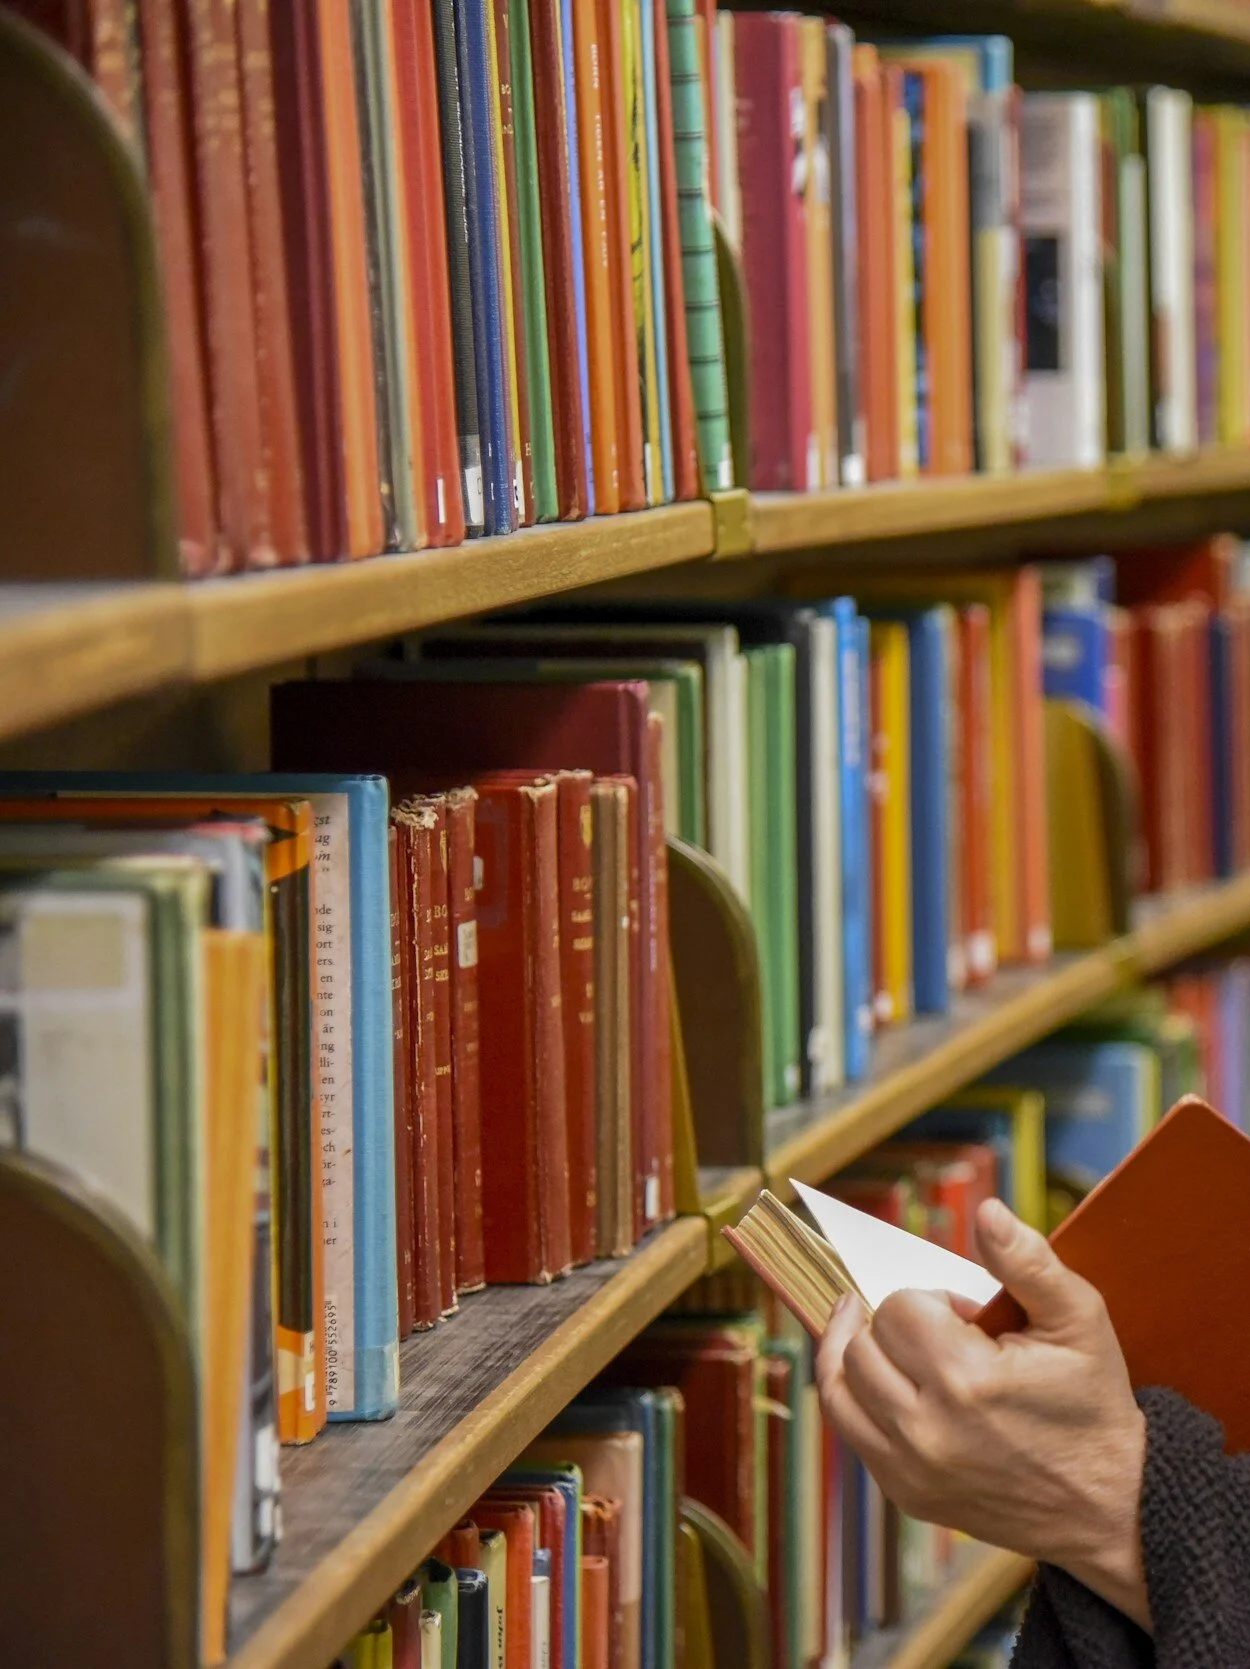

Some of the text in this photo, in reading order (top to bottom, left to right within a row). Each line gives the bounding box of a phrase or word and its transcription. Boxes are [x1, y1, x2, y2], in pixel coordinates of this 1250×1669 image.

[320, 974, 334, 982] en
[327, 1304, 338, 1345] 552695
[328, 1349, 338, 1392] 789100
